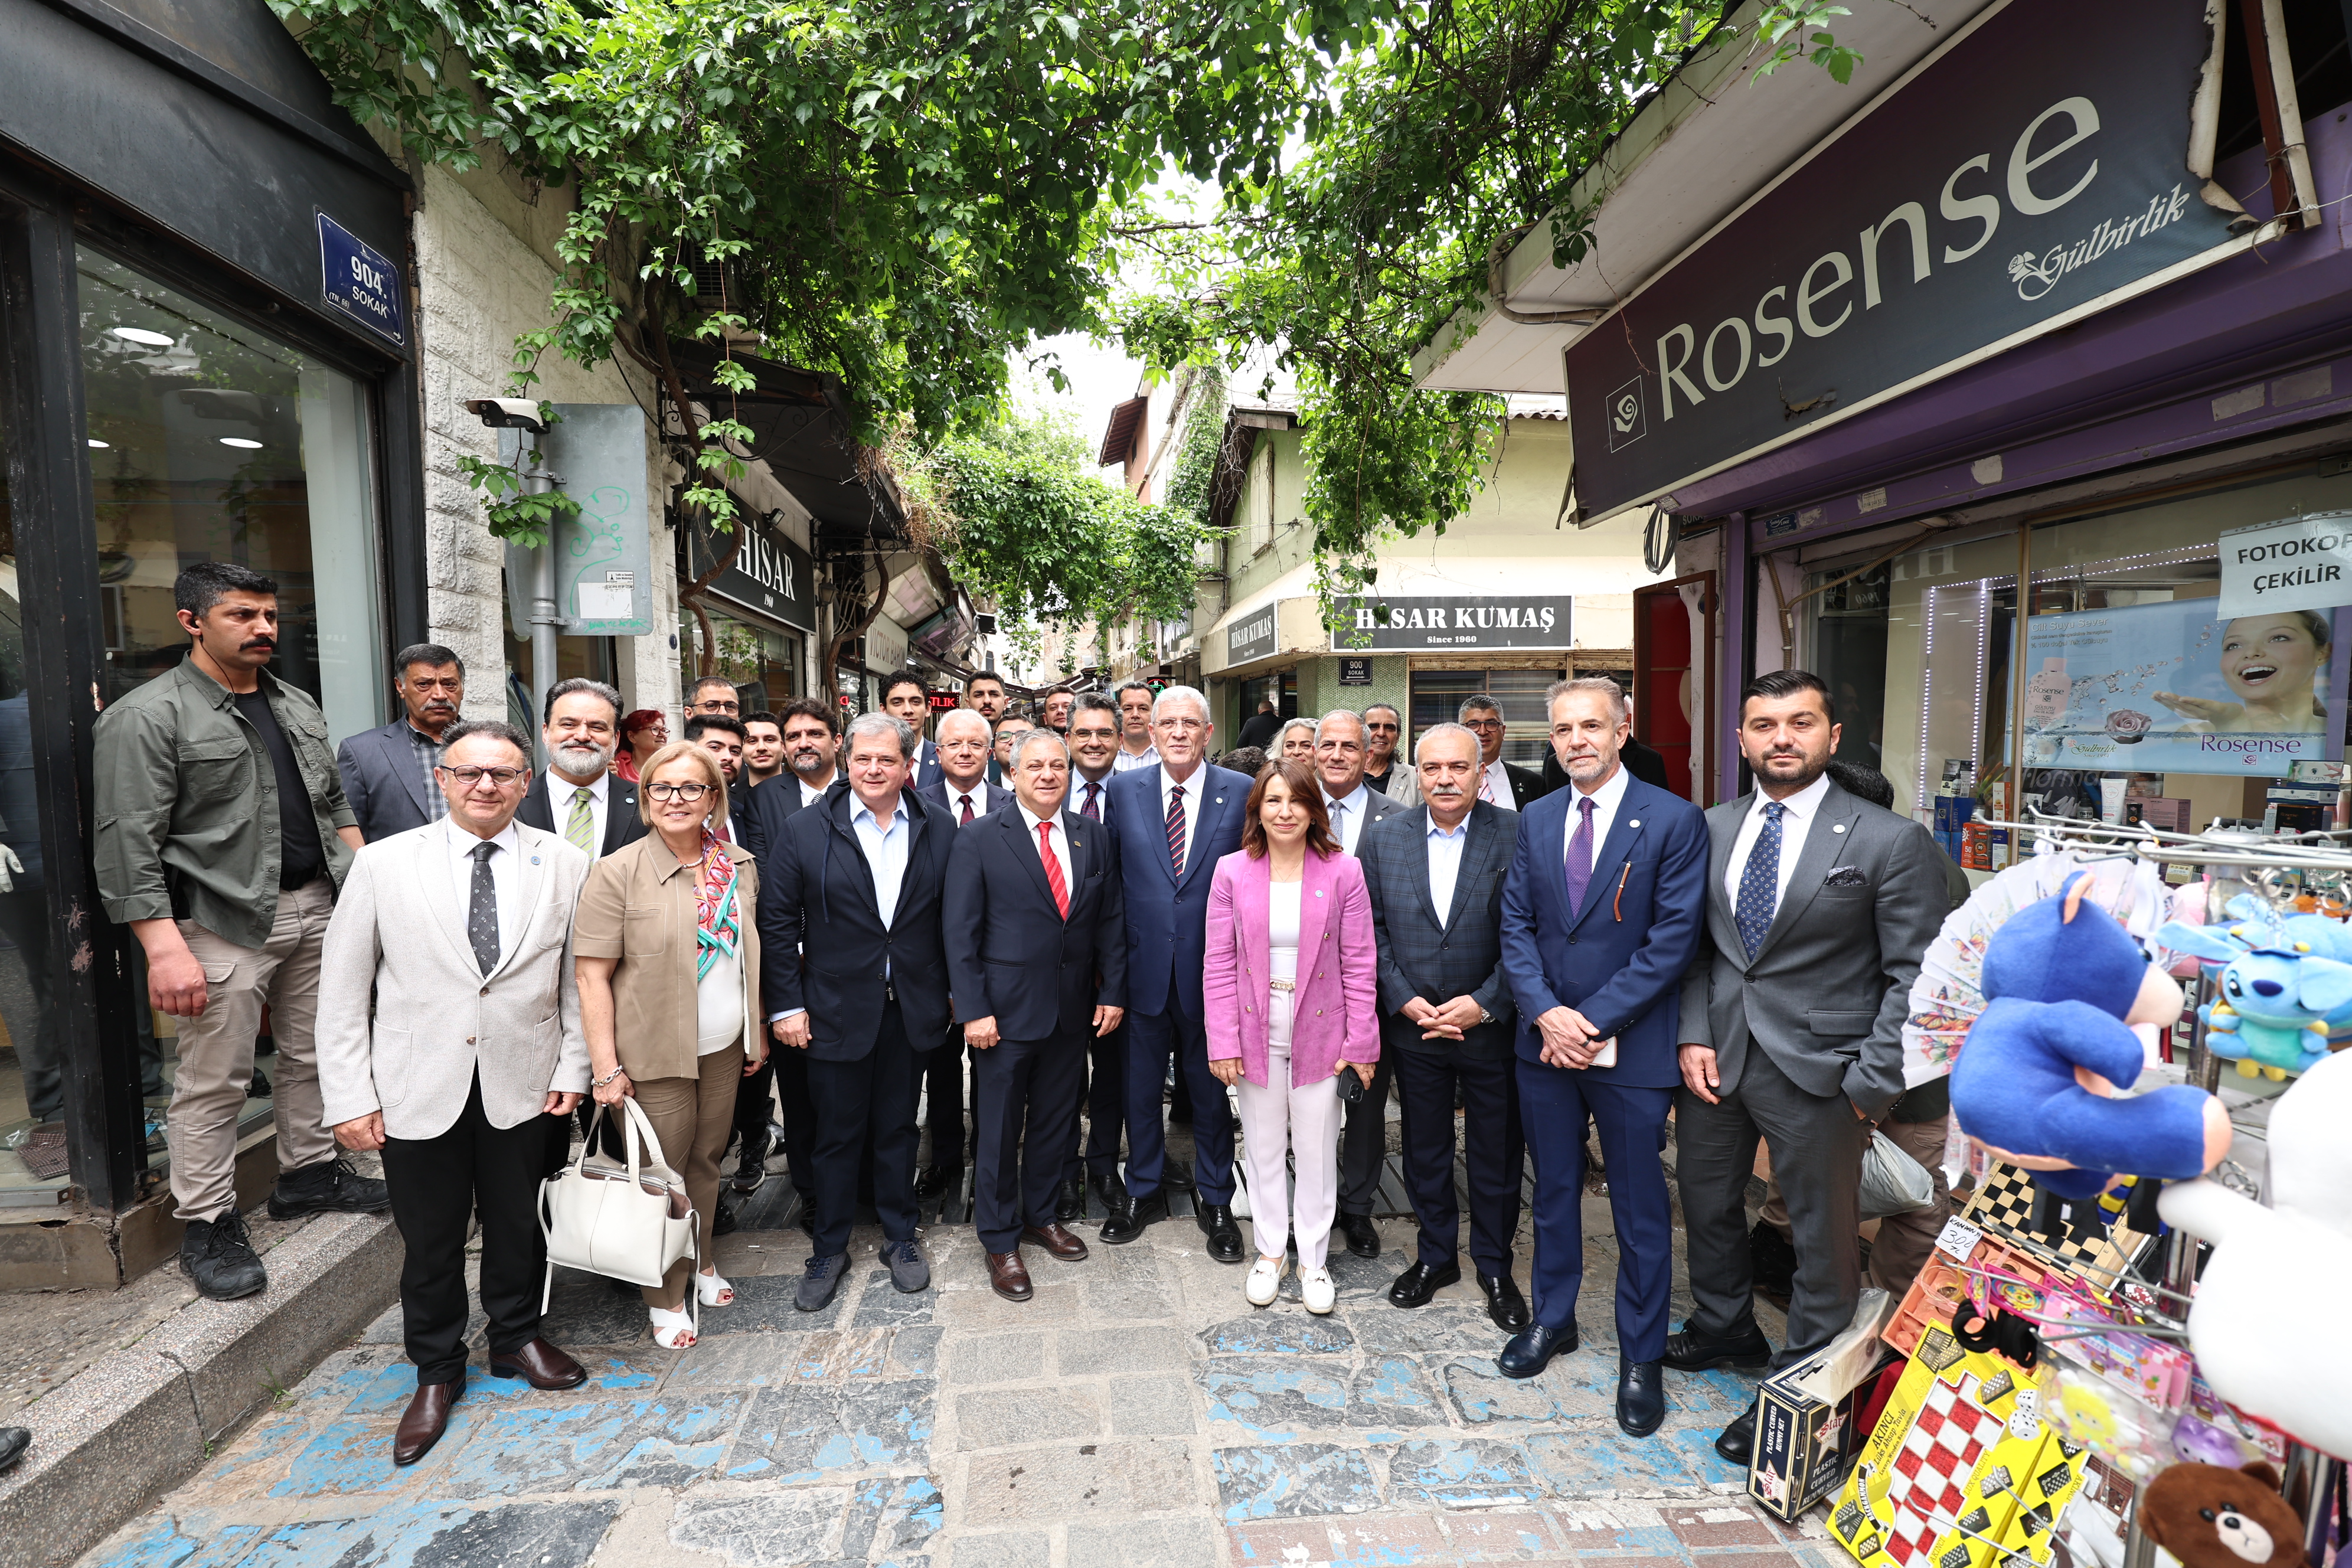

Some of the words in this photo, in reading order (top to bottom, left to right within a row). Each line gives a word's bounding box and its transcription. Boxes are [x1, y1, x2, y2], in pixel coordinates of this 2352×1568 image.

[2018, 182, 2190, 300] Gülbirlik
[1656, 96, 2101, 422] Rosense
[351, 256, 387, 299] 904.
[329, 291, 340, 303] (TN.
[341, 298, 349, 309] 66)
[352, 286, 388, 319] SOKAK
[735, 520, 795, 601] HİSAR
[2237, 533, 2352, 564] FOTOKOP
[2253, 563, 2341, 594] ÇEKİLİR
[764, 593, 773, 608] 1960
[1231, 626, 1248, 649] HİSAR
[1249, 615, 1272, 643] KUMAŞ
[1355, 607, 1448, 629] HSAR
[1455, 606, 1555, 633] KUMAŞ
[2031, 623, 2047, 632] Cilt
[2050, 621, 2075, 631] Suyu
[2077, 618, 2109, 628] Sever
[1455, 635, 1477, 643] 1960
[1350, 661, 1363, 669] 900
[2033, 685, 2064, 695] Rosense
[2071, 743, 2118, 755] Gülbirlik
[2201, 734, 2302, 753] Rosense
[1941, 1230, 1974, 1248] 300
[1766, 1427, 1775, 1454] PLASTIC
[1872, 1410, 1894, 1450] AKINCI
[1874, 1449, 1886, 1465] Lüks
[1883, 1428, 1897, 1449] Ahşap
[1893, 1408, 1906, 1428] Tavla
[1879, 1459, 1891, 1476] Luxury
[1888, 1441, 1900, 1459] Wooden
[1898, 1410, 1915, 1441] Backgammon
[1810, 1468, 1835, 1489] CURVED
[1812, 1454, 1839, 1478] PLASTIC
[1964, 1479, 1975, 1496] LUX
[1974, 1450, 1990, 1481] QUALITY
[1802, 1484, 1825, 1506] RUMMY
[1825, 1476, 1838, 1494] SET
[1858, 1478, 1876, 1521] BACKGAMMON
[1929, 1537, 1945, 1563] AKINCI
